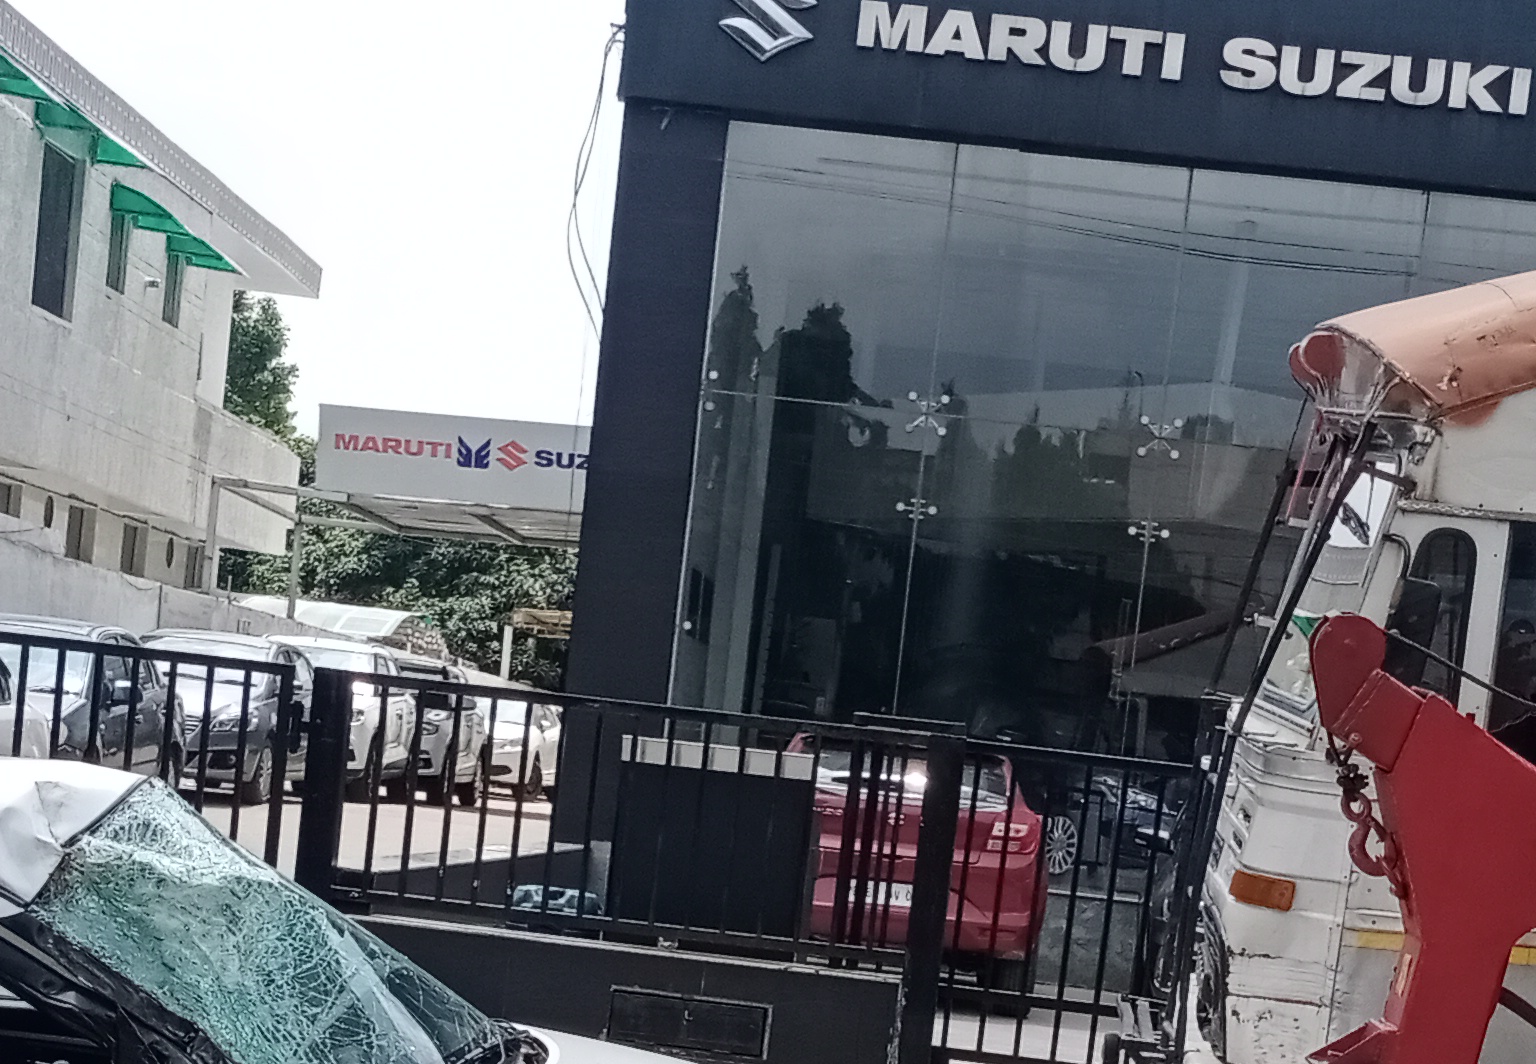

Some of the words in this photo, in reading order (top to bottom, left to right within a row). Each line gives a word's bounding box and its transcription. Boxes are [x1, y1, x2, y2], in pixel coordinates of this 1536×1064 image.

[855, 1, 1186, 81] MARUTI
[1220, 37, 1534, 116] SUZUKI
[334, 433, 453, 459] MARUTI
